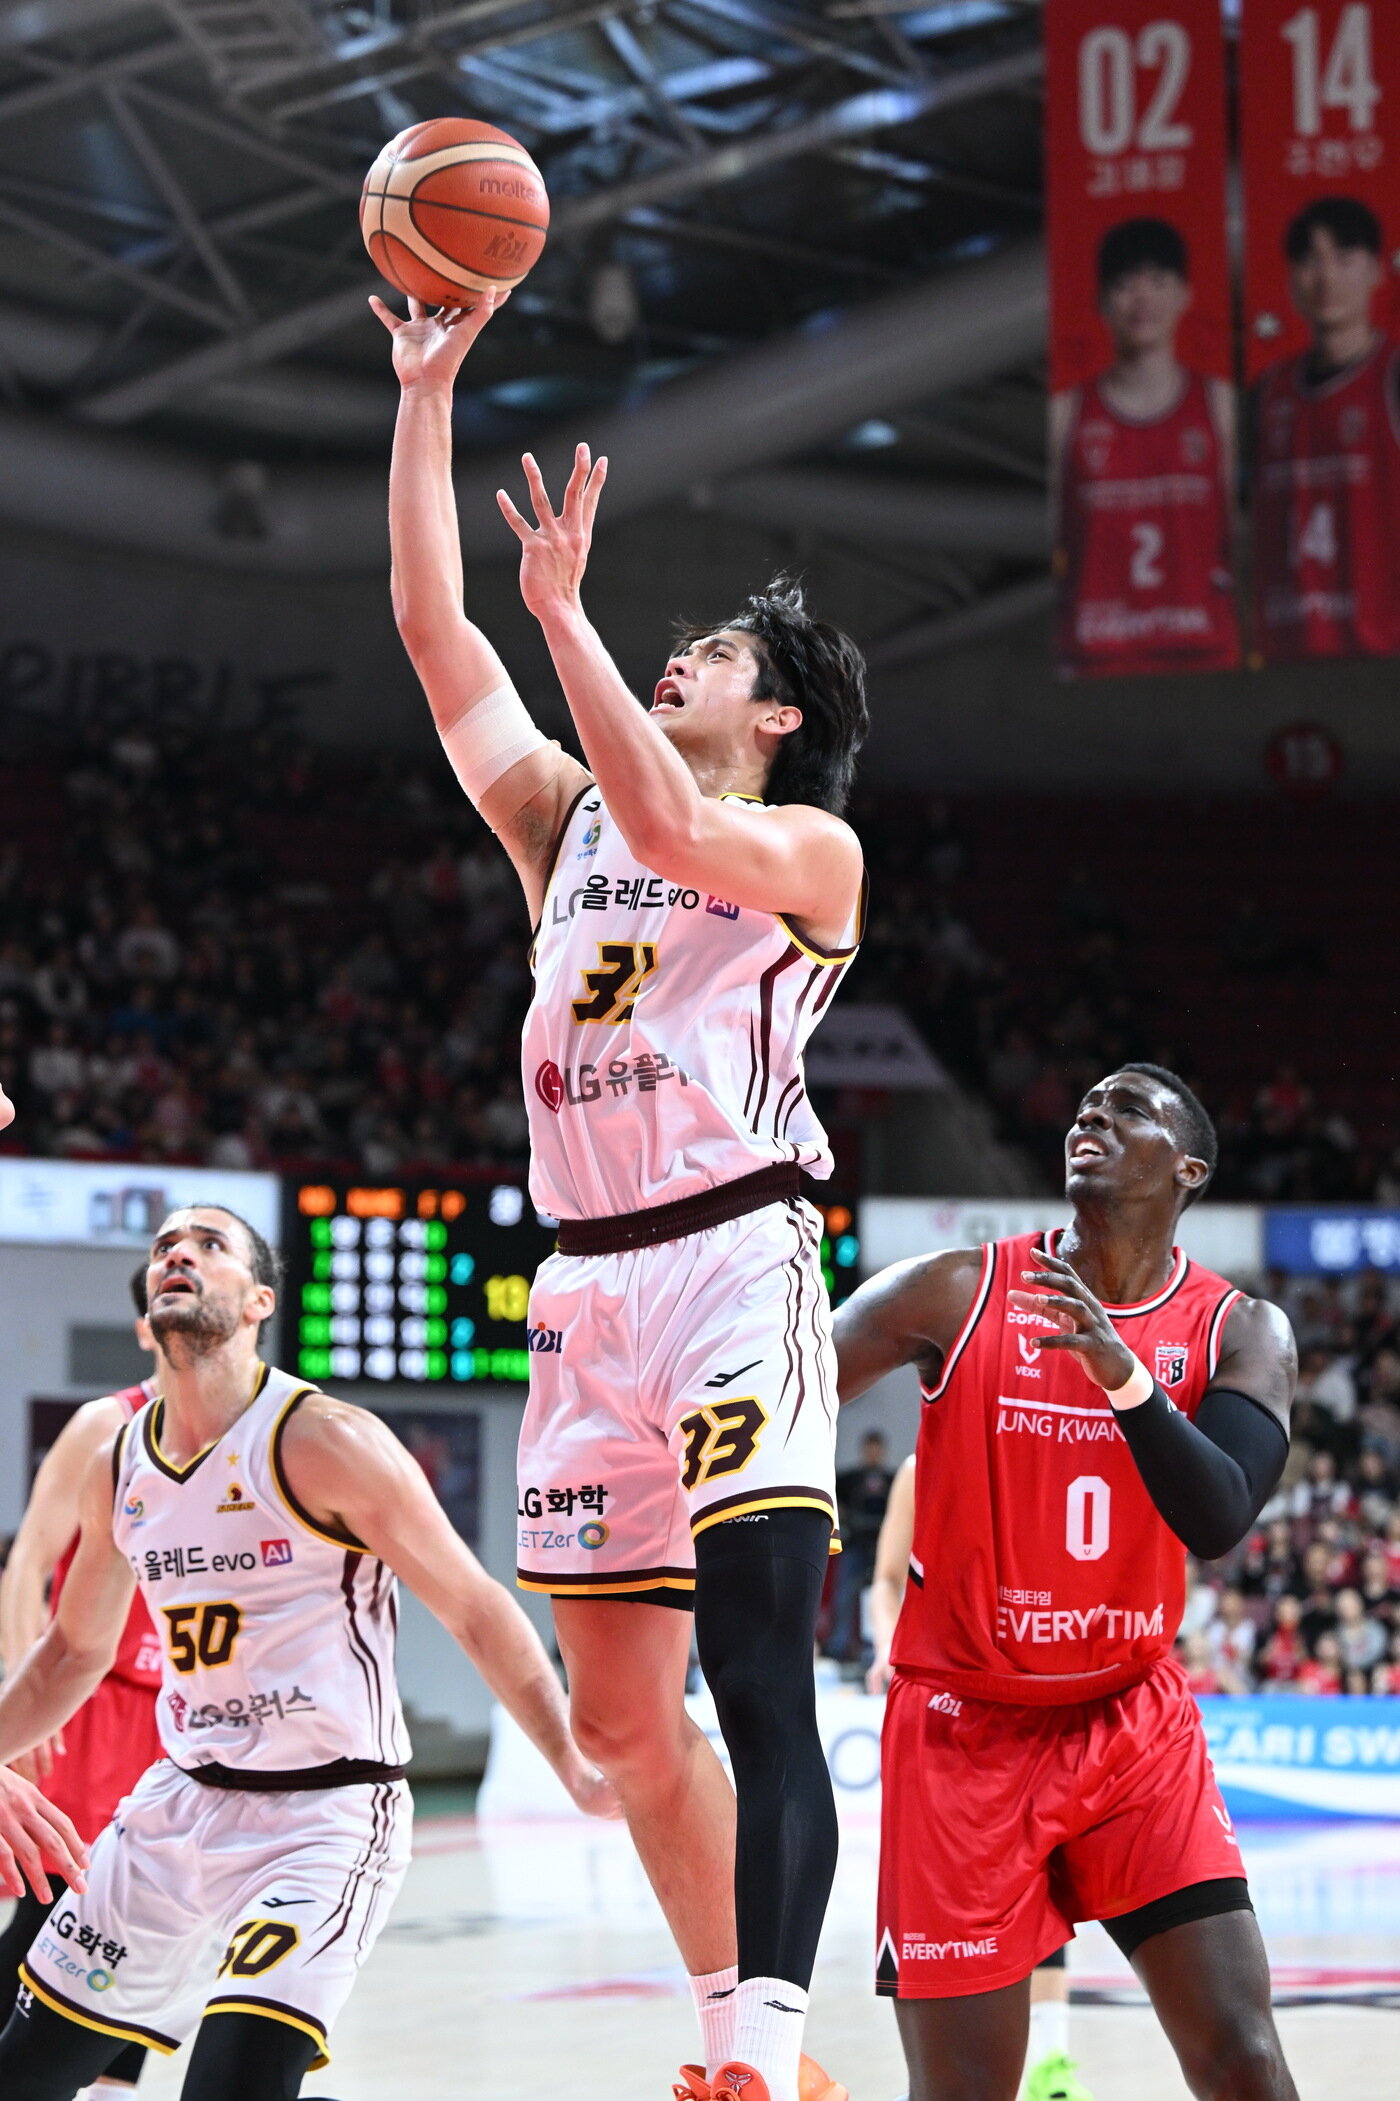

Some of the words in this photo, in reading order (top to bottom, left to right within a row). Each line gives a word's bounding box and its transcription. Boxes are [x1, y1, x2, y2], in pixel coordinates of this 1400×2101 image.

[1077, 20, 1193, 156] 02
[1281, 3, 1380, 138] 14
[1130, 522, 1163, 589] 2
[581, 874, 664, 911] 올레드
[564, 1063, 602, 1106] LG
[604, 1052, 695, 1098] 유플러
[1015, 1365, 1041, 1379] VEXX
[545, 1484, 608, 1517] 화학
[1065, 1475, 1111, 1561] 0
[144, 1547, 208, 1581] 올레드
[212, 1552, 256, 1572] evo
[264, 1543, 290, 1564] AI
[1000, 1584, 1051, 1606] 브리타임
[160, 1600, 243, 1677] 50
[927, 1692, 963, 1717] KBL
[74, 1924, 128, 1970] 화학
